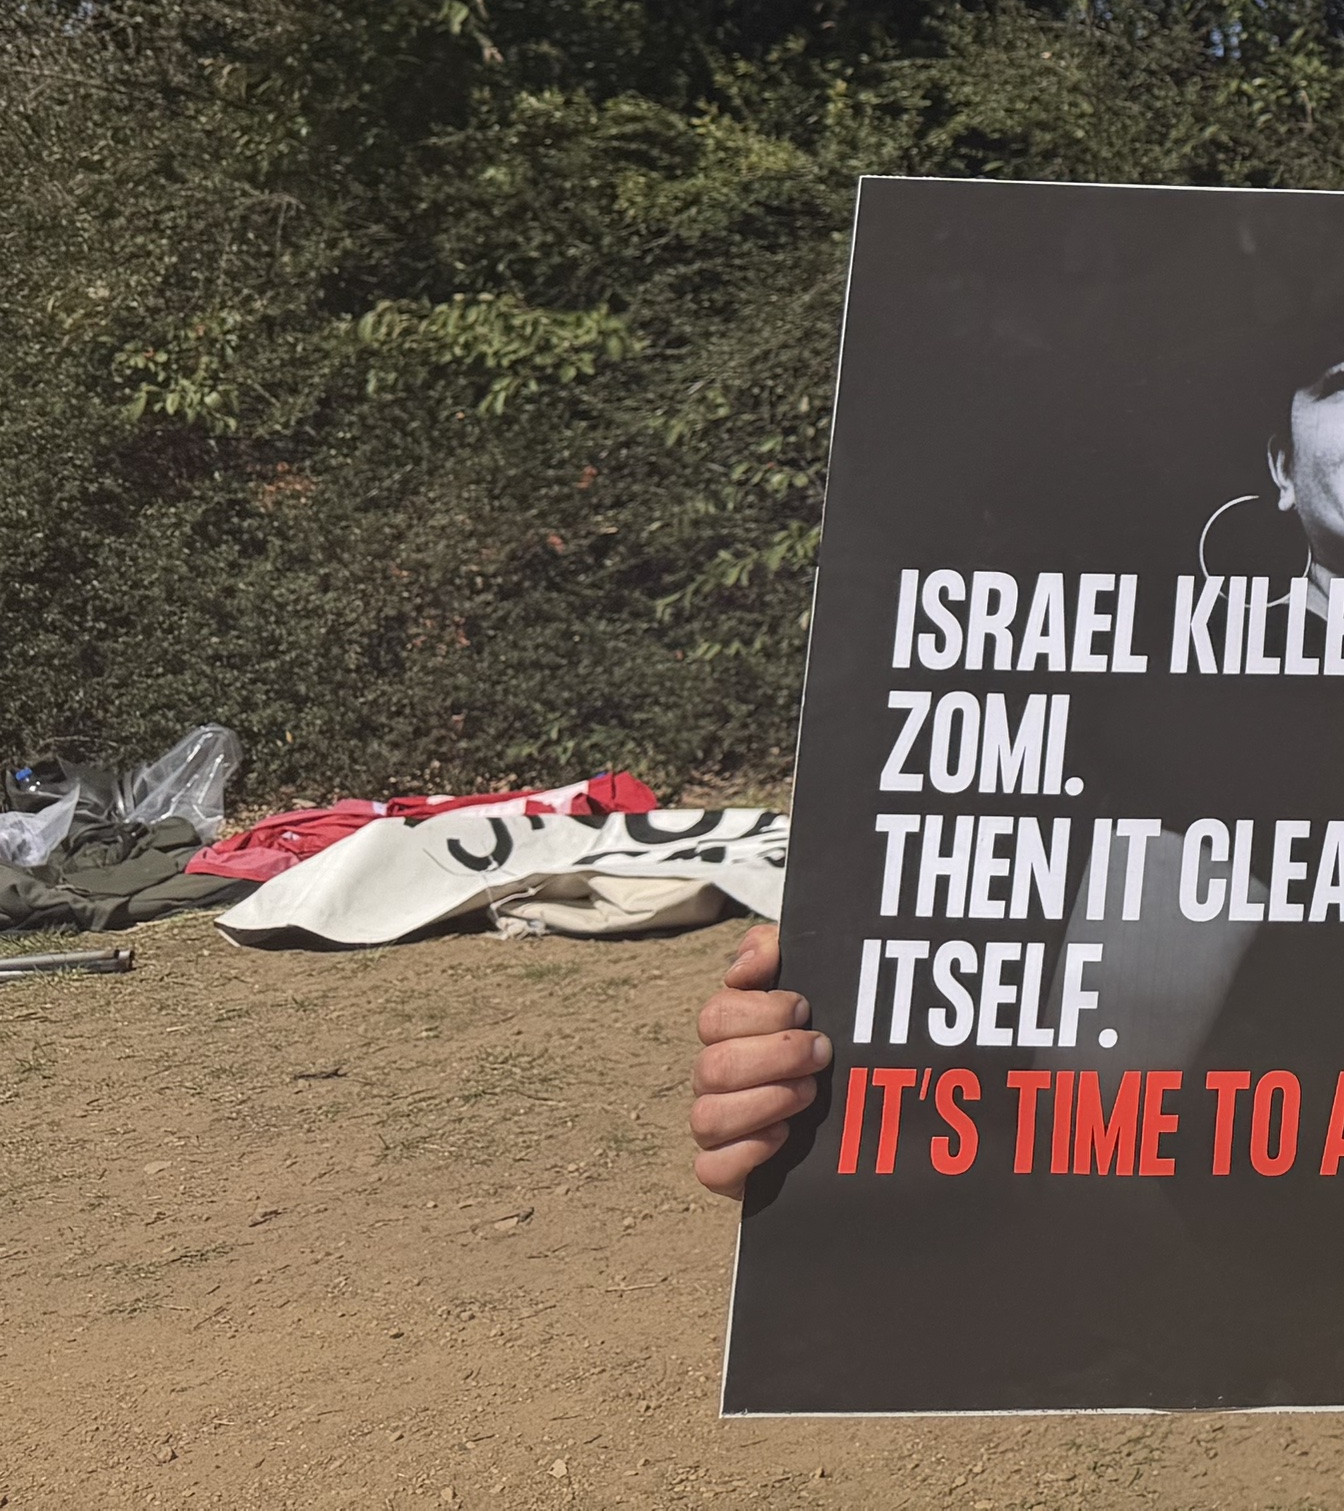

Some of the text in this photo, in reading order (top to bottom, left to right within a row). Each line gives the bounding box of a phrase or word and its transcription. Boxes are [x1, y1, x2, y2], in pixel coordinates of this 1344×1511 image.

[892, 568, 1148, 674] ISRAEL
[879, 690, 1085, 796] ZOMI.
[875, 814, 1072, 920] THEN
[1085, 818, 1162, 921] IT
[853, 939, 1119, 1048] ITSELF.
[838, 1067, 982, 1175] IT'S
[1006, 1070, 1184, 1176] TIME
[1205, 1070, 1302, 1177] TO
